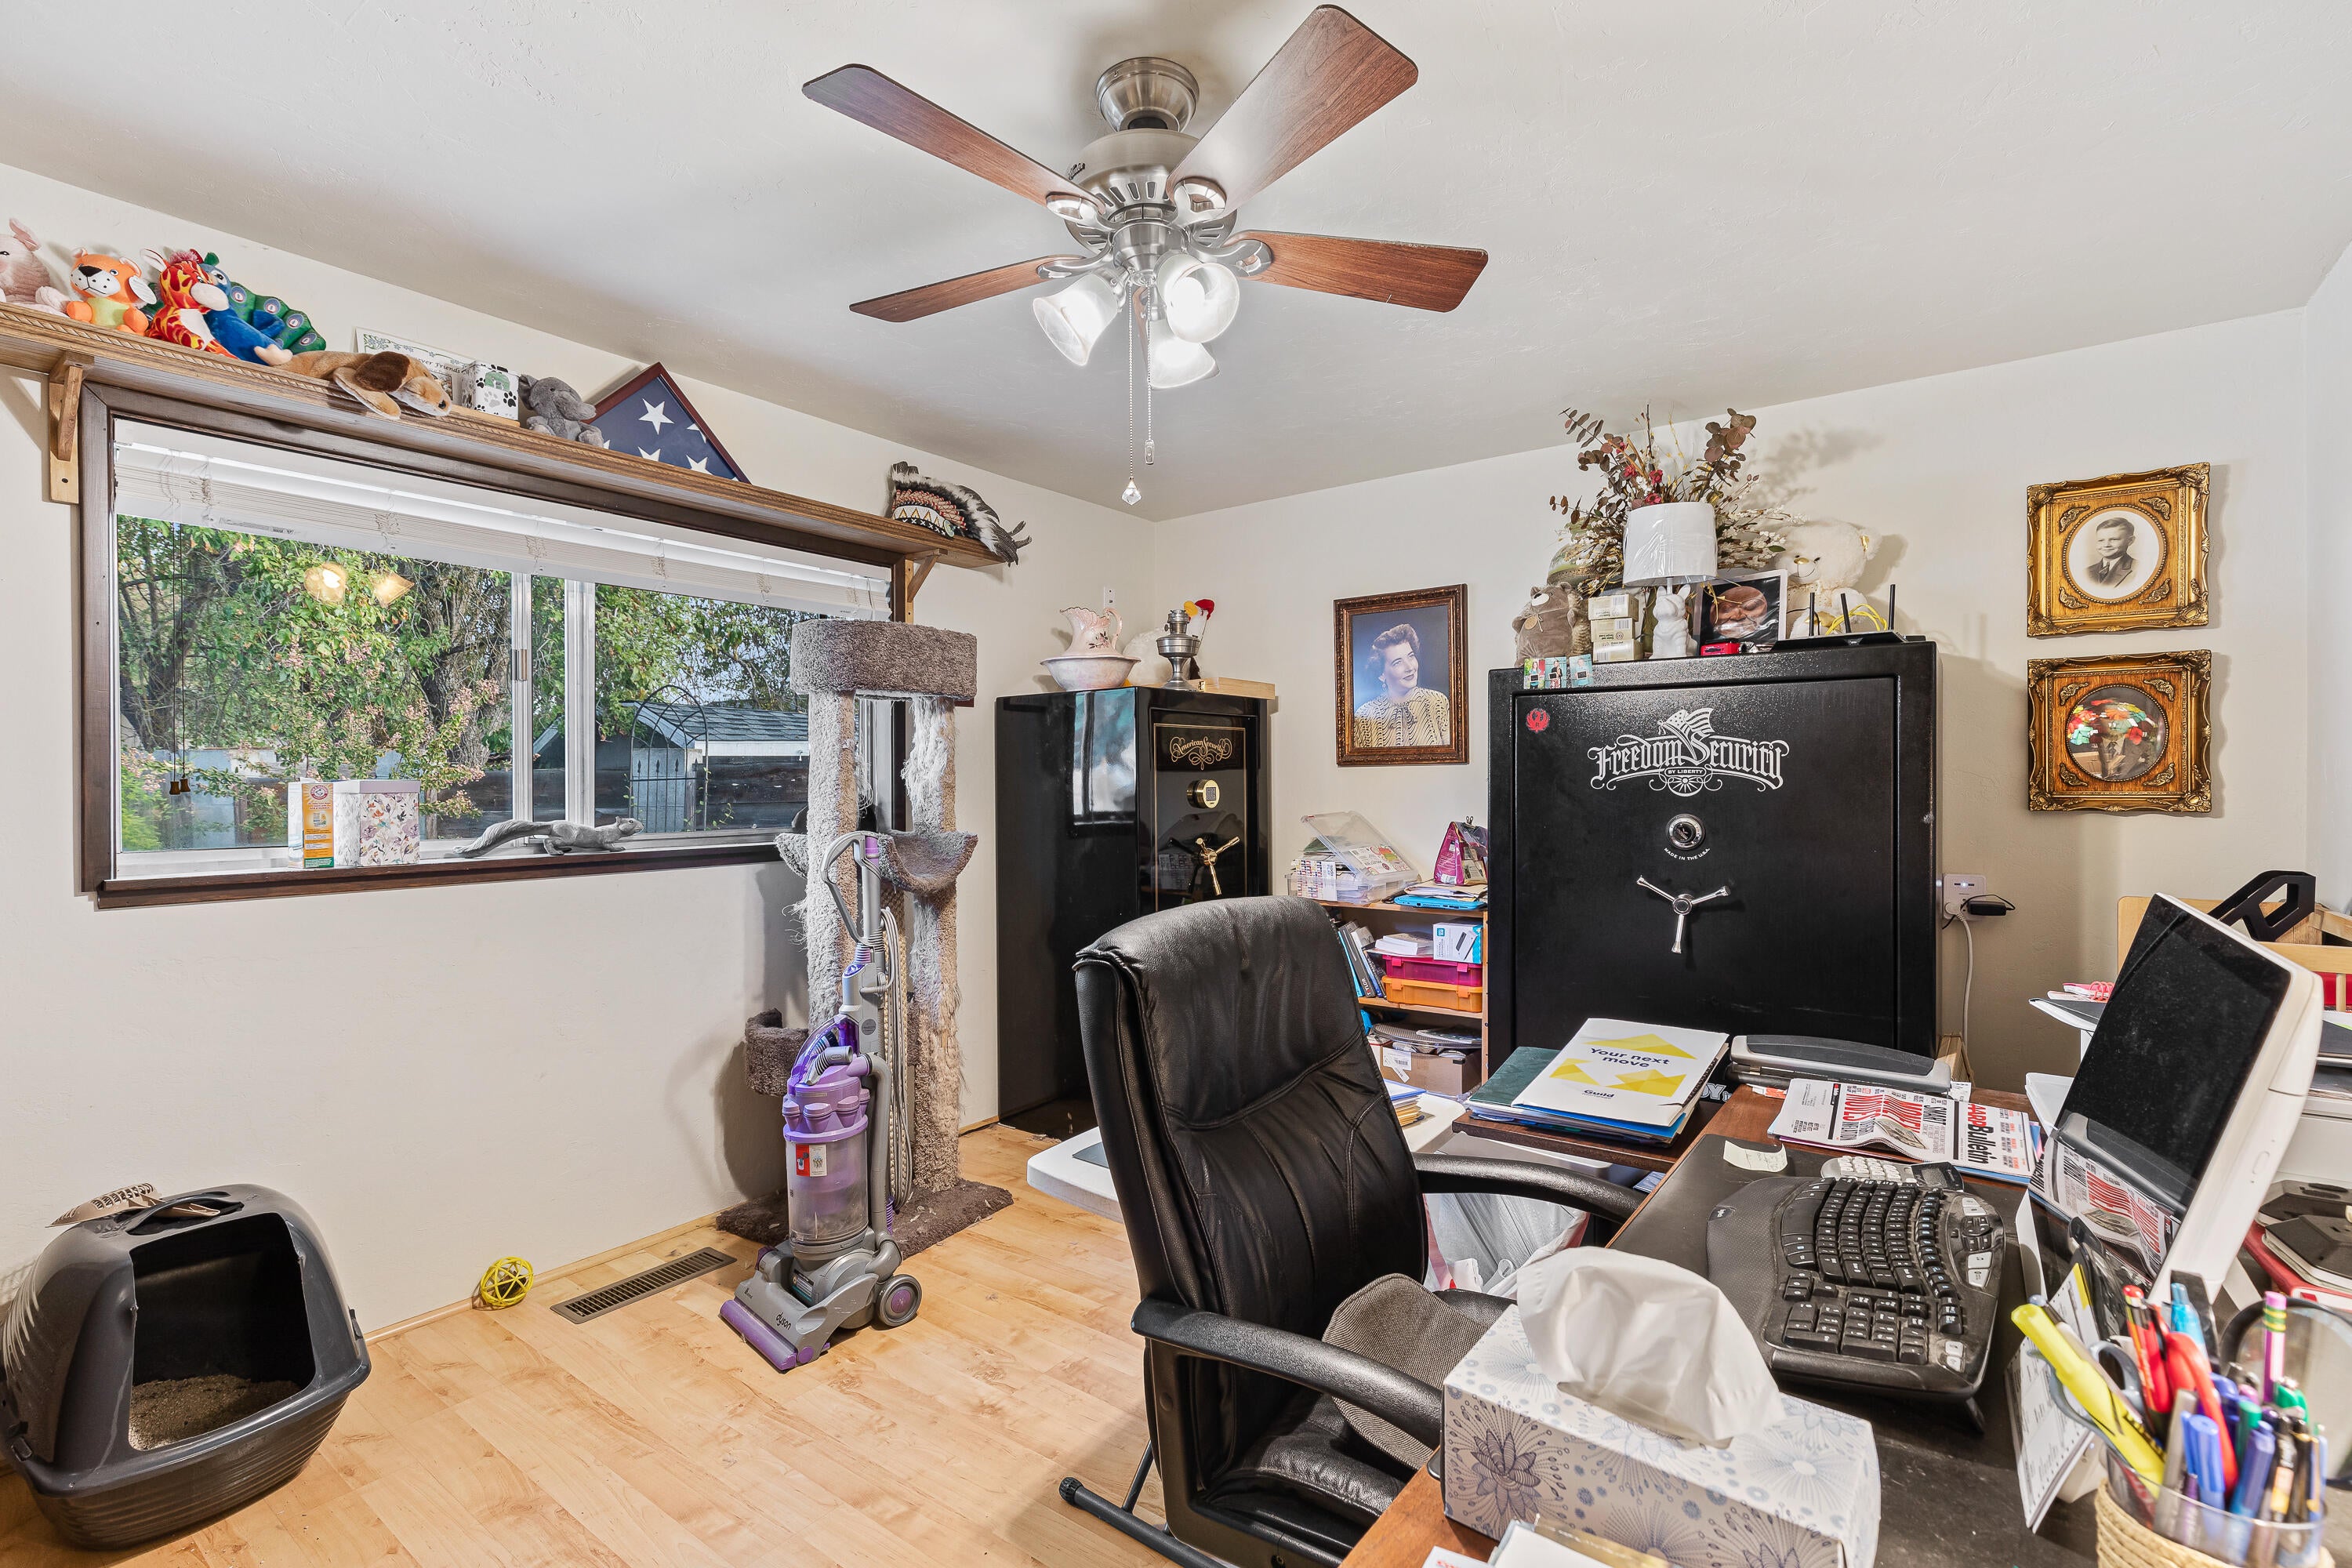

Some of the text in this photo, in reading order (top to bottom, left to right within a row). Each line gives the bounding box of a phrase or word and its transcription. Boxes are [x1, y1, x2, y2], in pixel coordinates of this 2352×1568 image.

[434, 362, 461, 374] Friends
[1588, 734, 1789, 789] Freedom Security
[1664, 847, 1679, 858] MADE
[1590, 1047, 1671, 1065] Your next
[1602, 1056, 1650, 1068] move
[1584, 1089, 1615, 1098] Guild
[1842, 1094, 1883, 1121] MOVES
[1882, 1094, 1923, 1134] MONEY
[1922, 1105, 1947, 1126] SMART
[1967, 1104, 1998, 1164] AARP Bulletin
[776, 1312, 791, 1330] dyson
